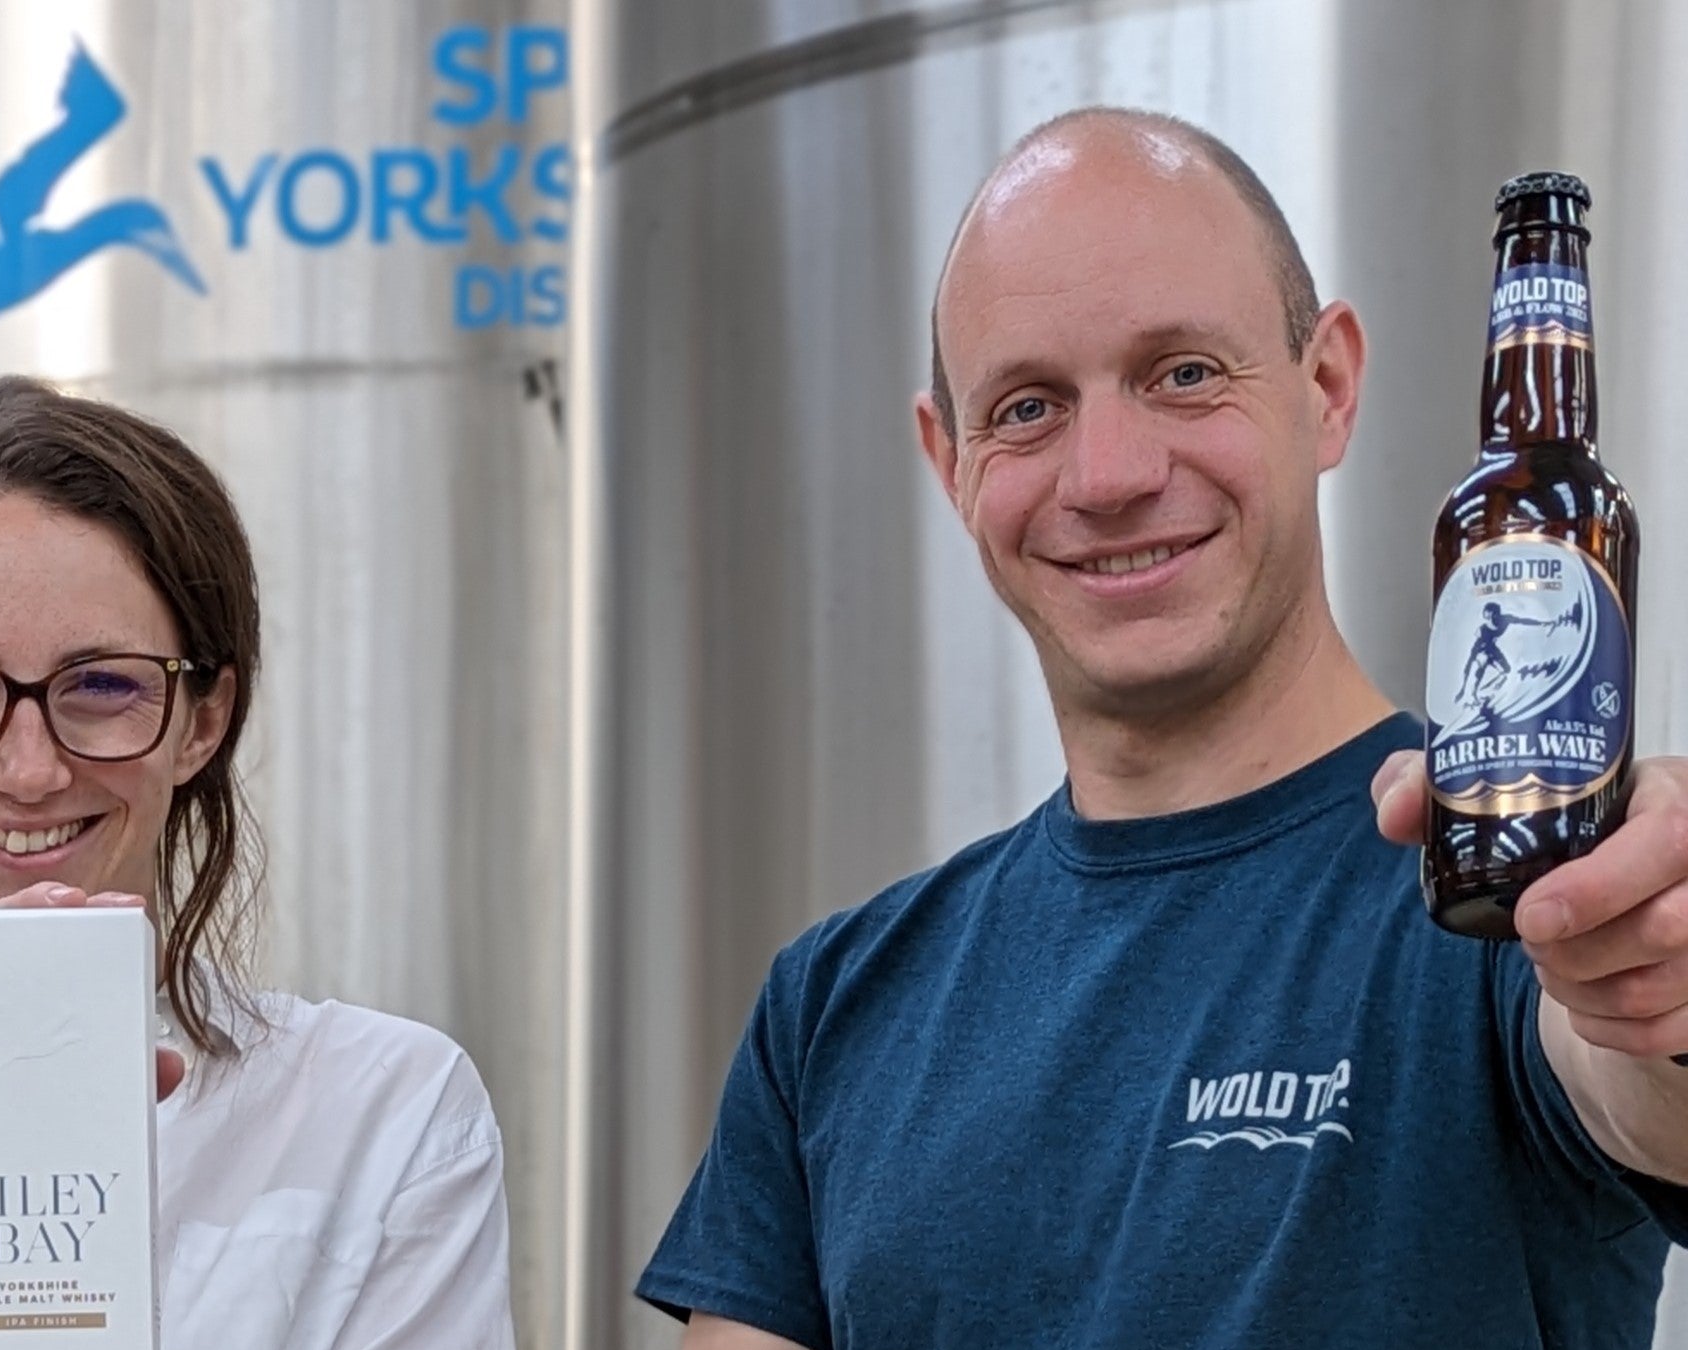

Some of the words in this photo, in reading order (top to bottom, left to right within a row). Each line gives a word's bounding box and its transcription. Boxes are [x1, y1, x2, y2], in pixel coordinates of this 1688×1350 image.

[433, 24, 568, 126] SP
[454, 264, 567, 330] DIS
[1493, 277, 1548, 312] WOLD
[1472, 561, 1523, 586] WOLD
[1434, 733, 1537, 773] BARREL
[1538, 733, 1606, 763] WAVE
[1186, 1071, 1299, 1123] WOLD
[0, 1280, 79, 1292] YORKSHIRE
[19, 1293, 54, 1304] MALT
[62, 1292, 116, 1303] WHISKY
[6, 1317, 27, 1327] IPA
[33, 1316, 77, 1326] FINISH
